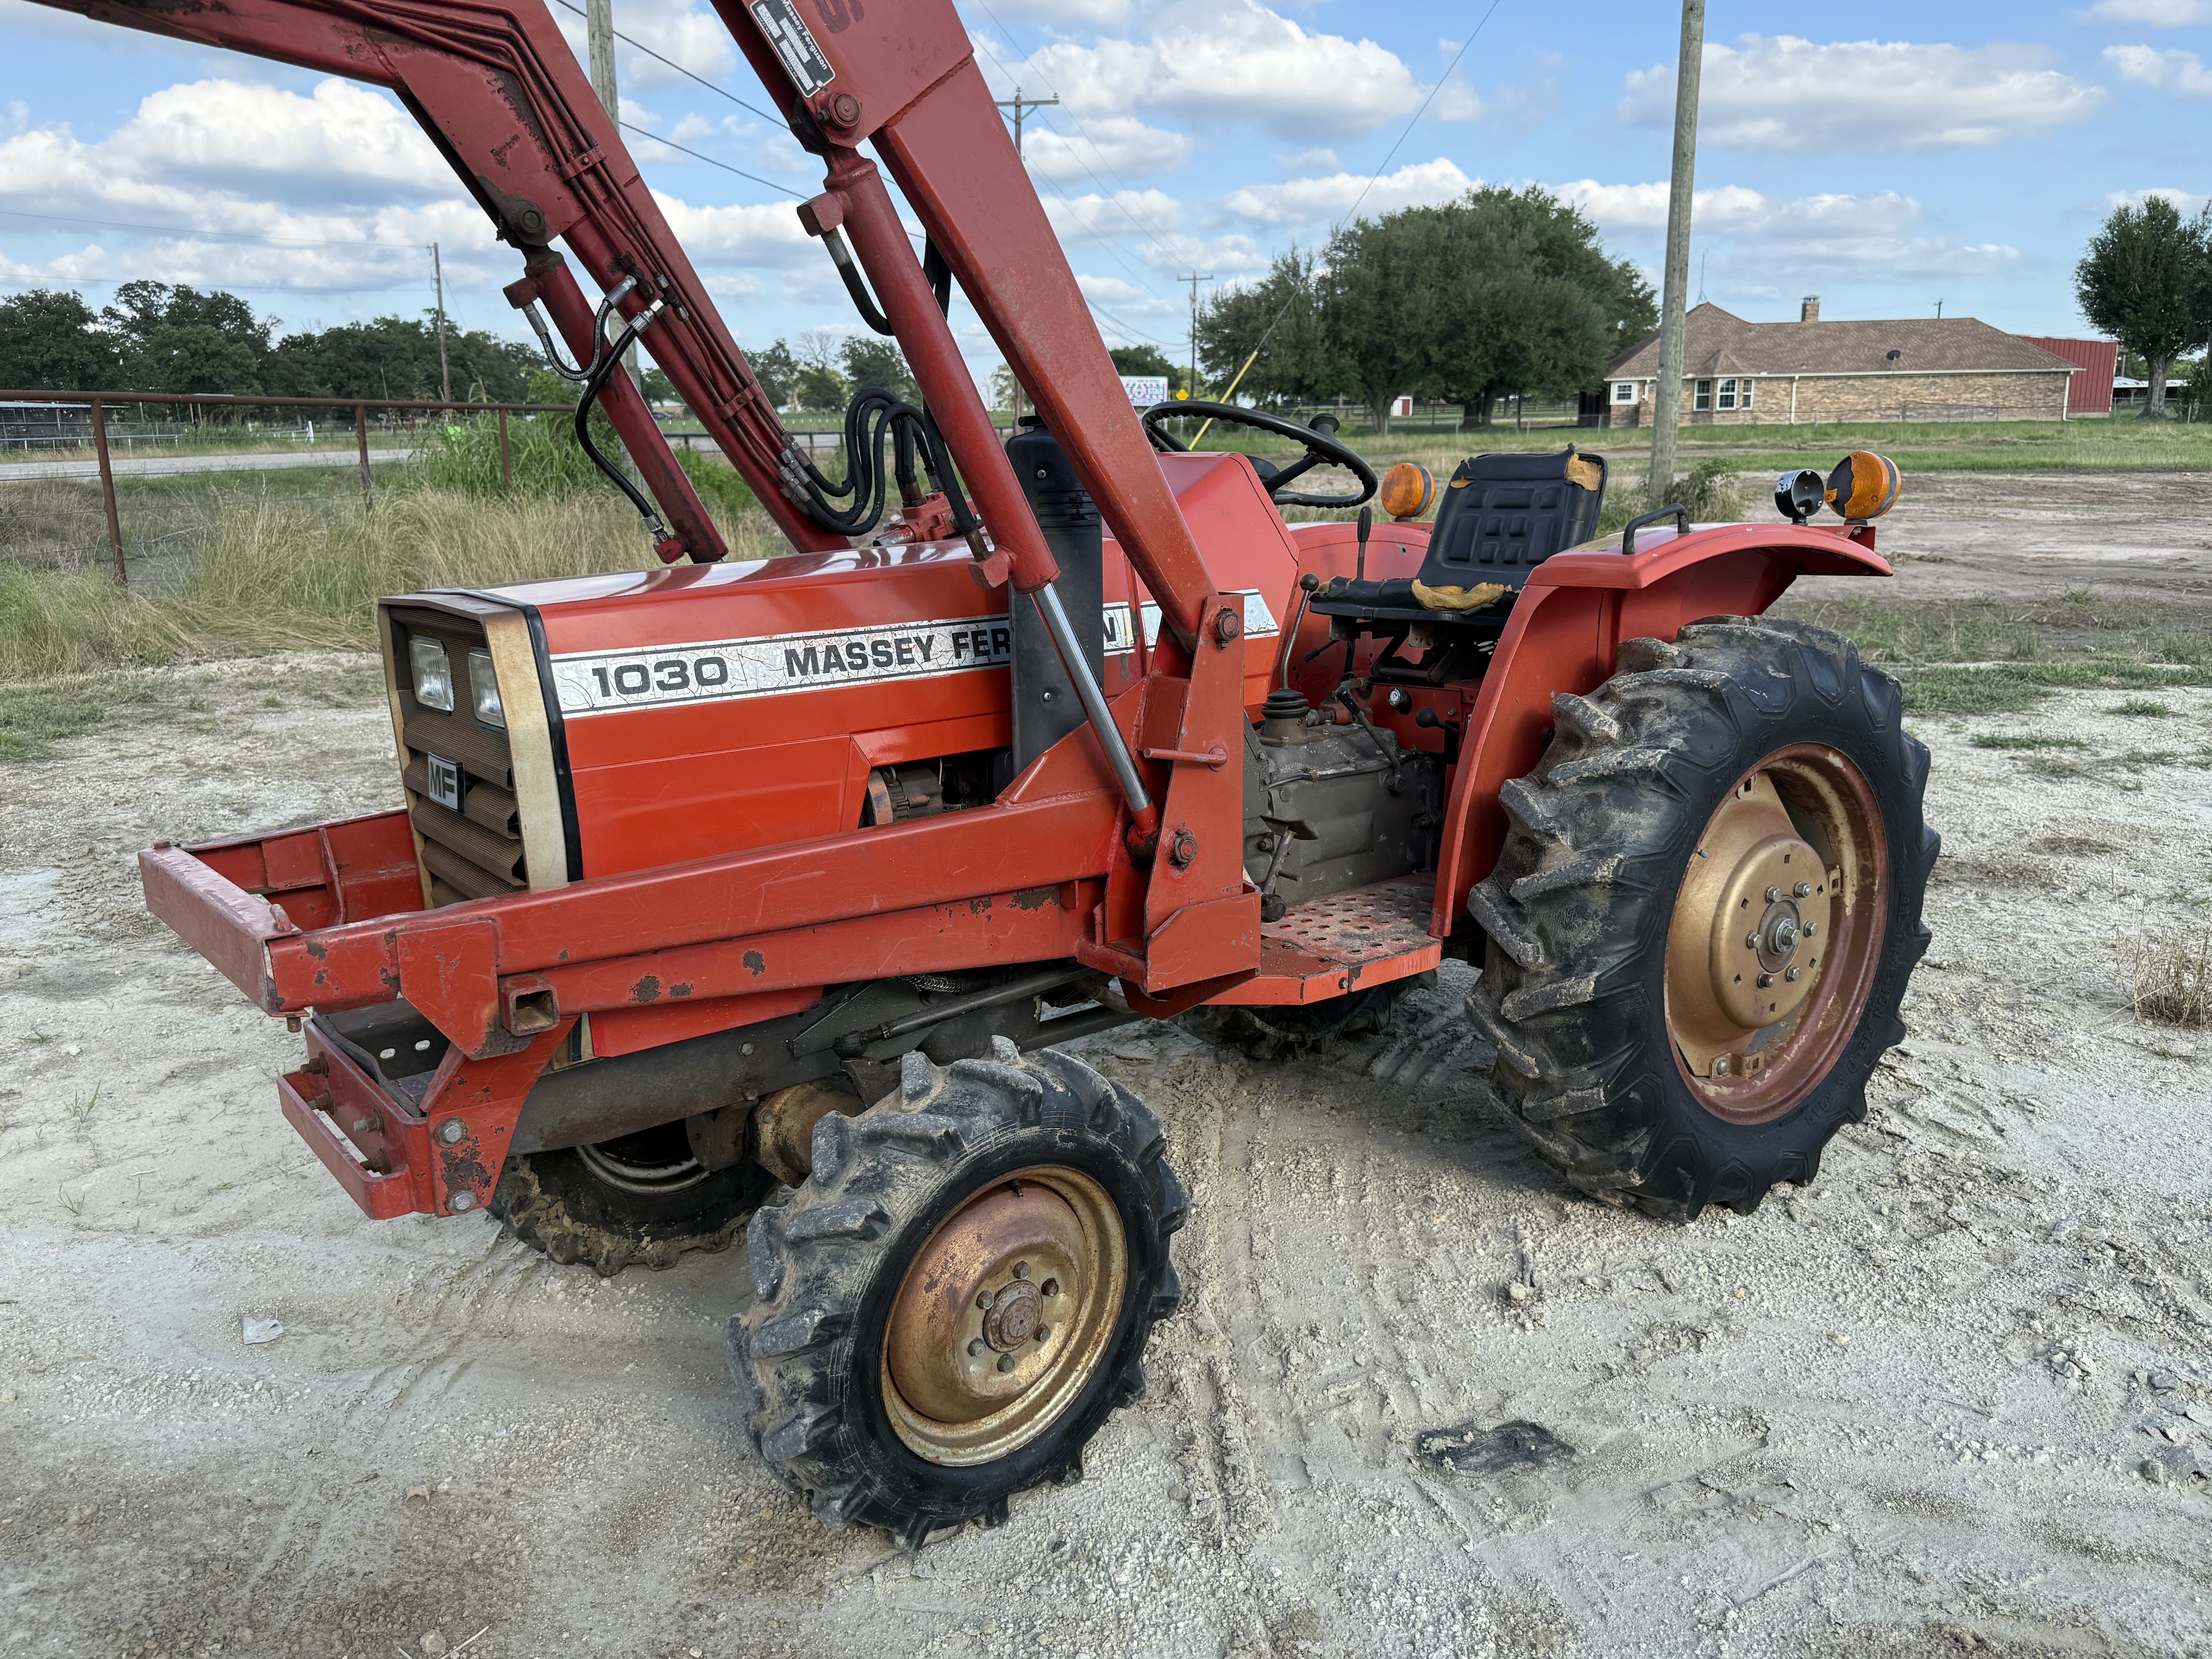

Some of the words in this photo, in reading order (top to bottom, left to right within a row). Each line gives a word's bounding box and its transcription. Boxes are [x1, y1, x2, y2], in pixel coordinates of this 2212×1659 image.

[780, 0, 804, 31] Massey
[800, 30, 829, 71] Ferguson
[592, 657, 728, 697] 1030
[784, 635, 934, 677] MASSEY
[430, 761, 455, 799] MF
[1847, 1024, 1875, 1073] FIELD
